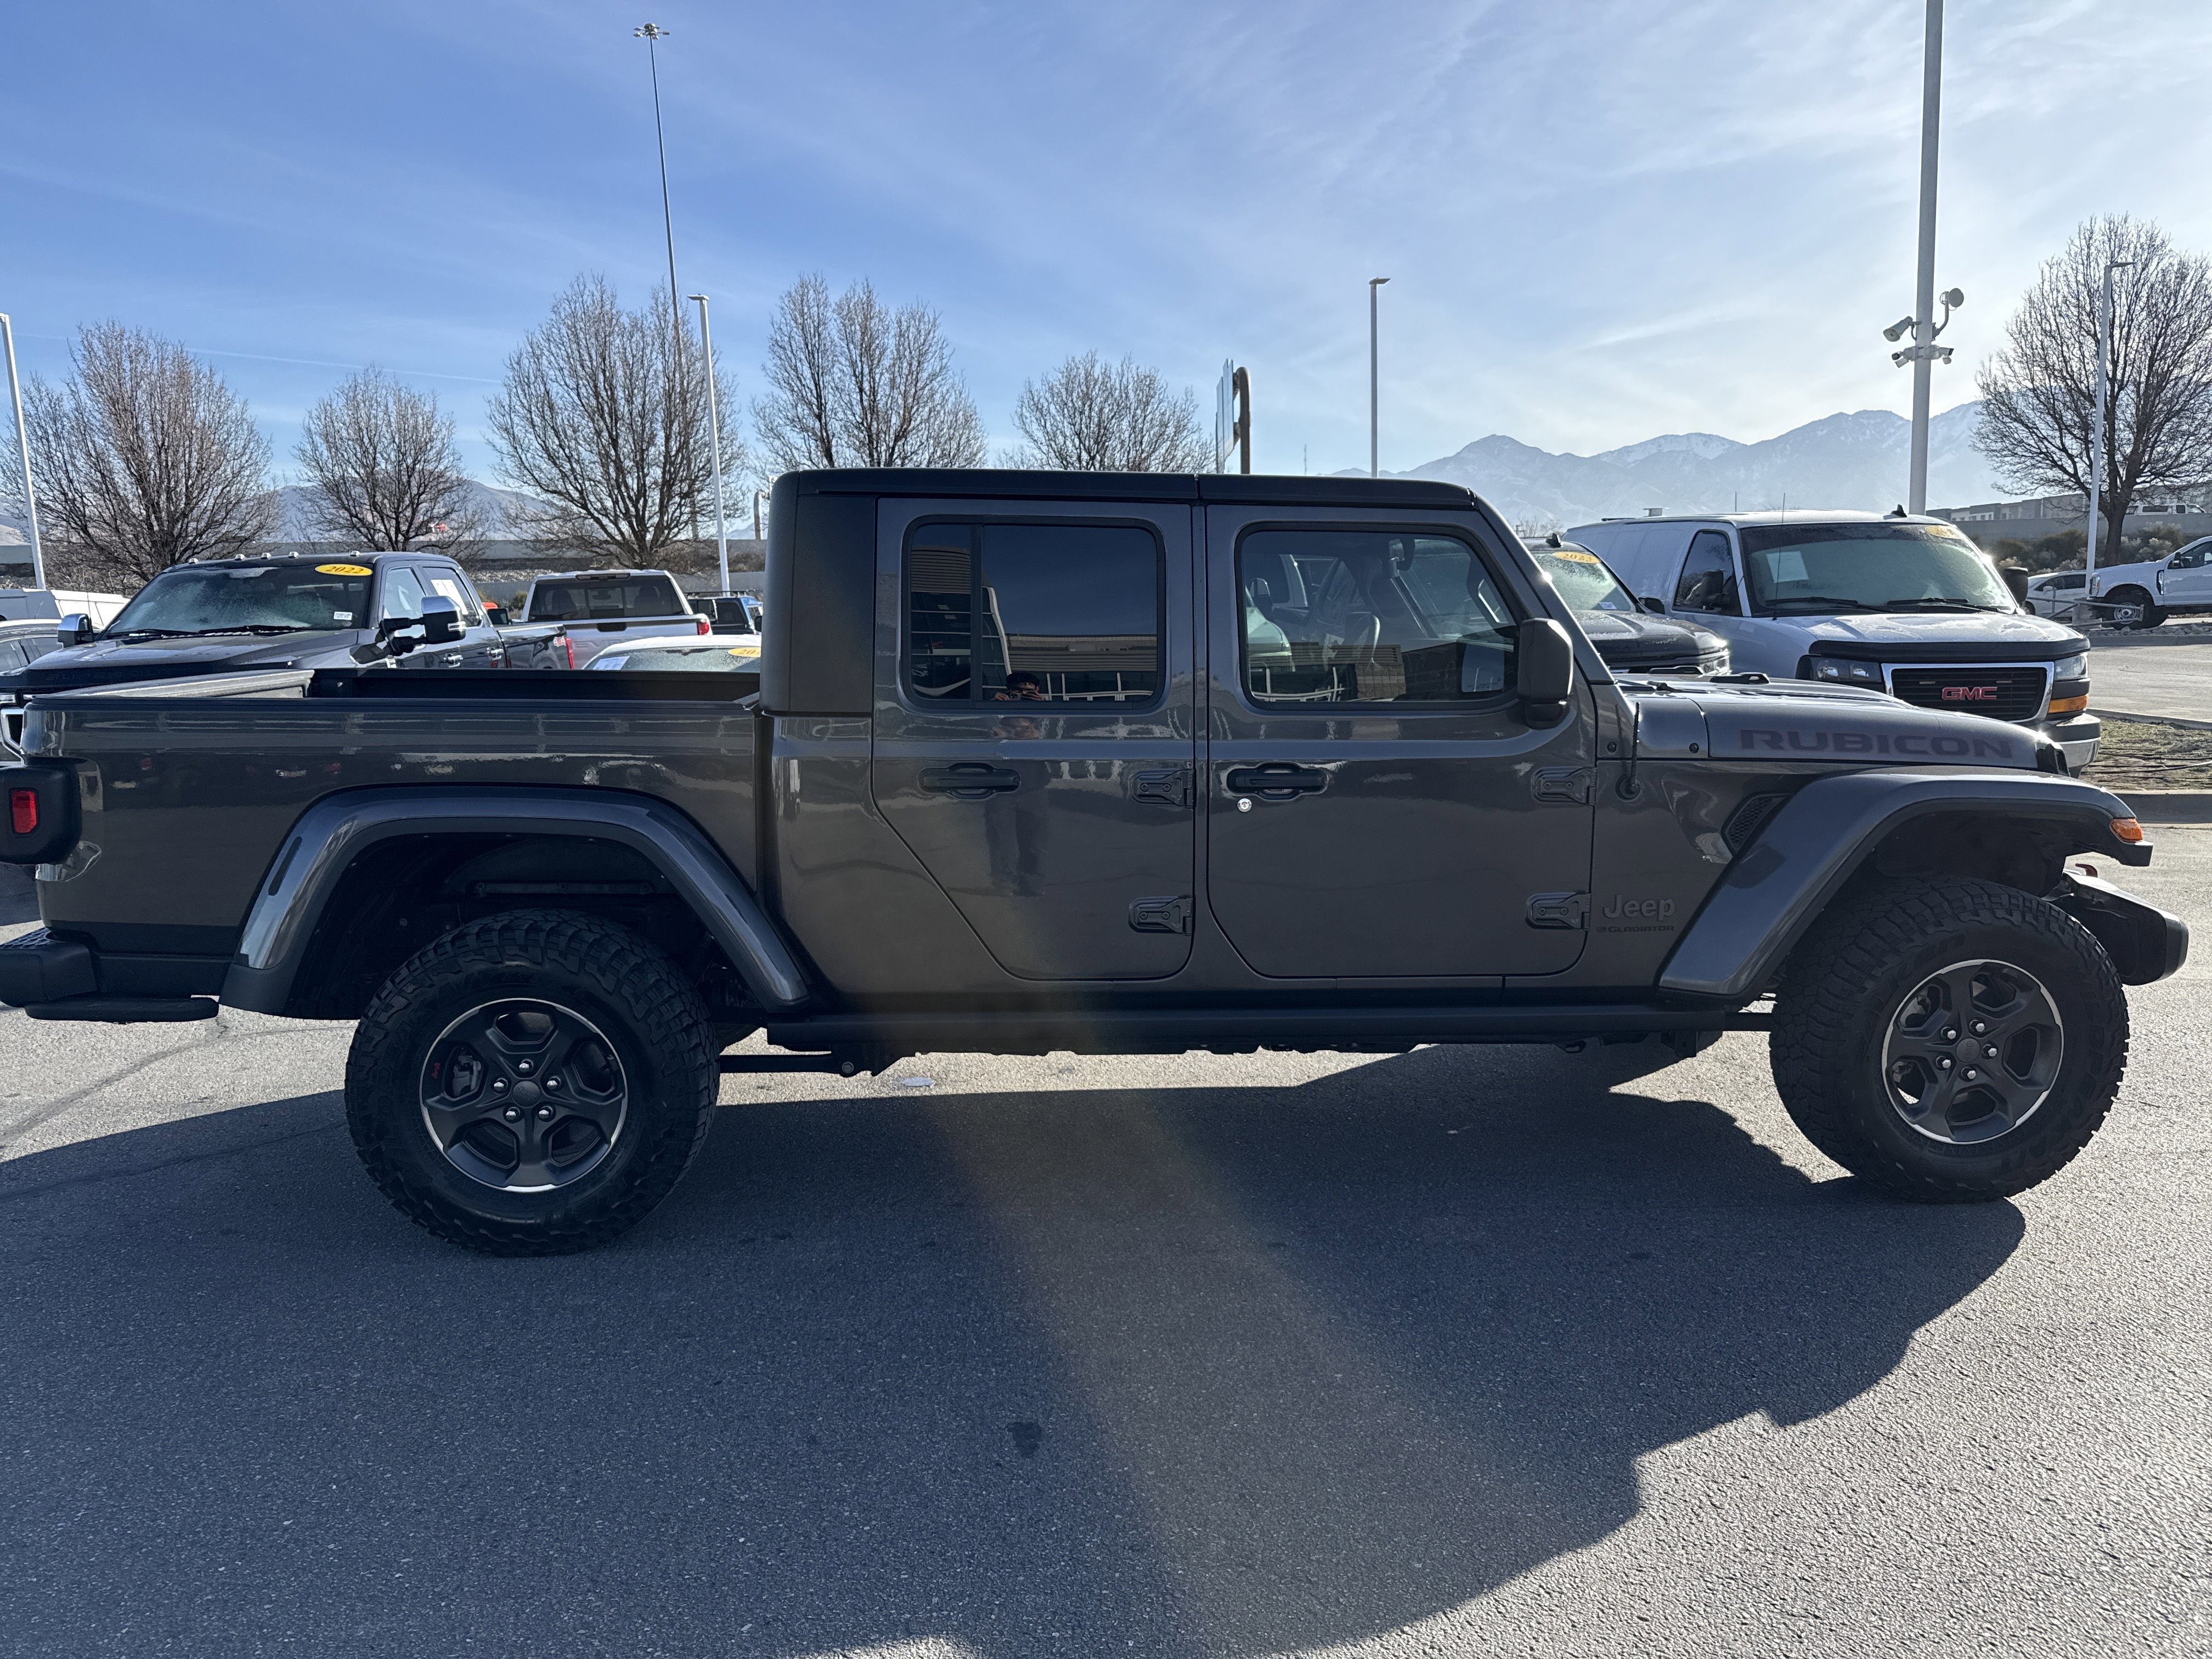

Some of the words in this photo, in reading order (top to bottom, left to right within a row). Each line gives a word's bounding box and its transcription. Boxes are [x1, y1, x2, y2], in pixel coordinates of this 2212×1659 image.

[325, 566, 364, 574] 2022
[1942, 686, 1997, 700] GMC
[1738, 729, 2014, 759] RUBICON
[1602, 894, 1675, 921] Jeep
